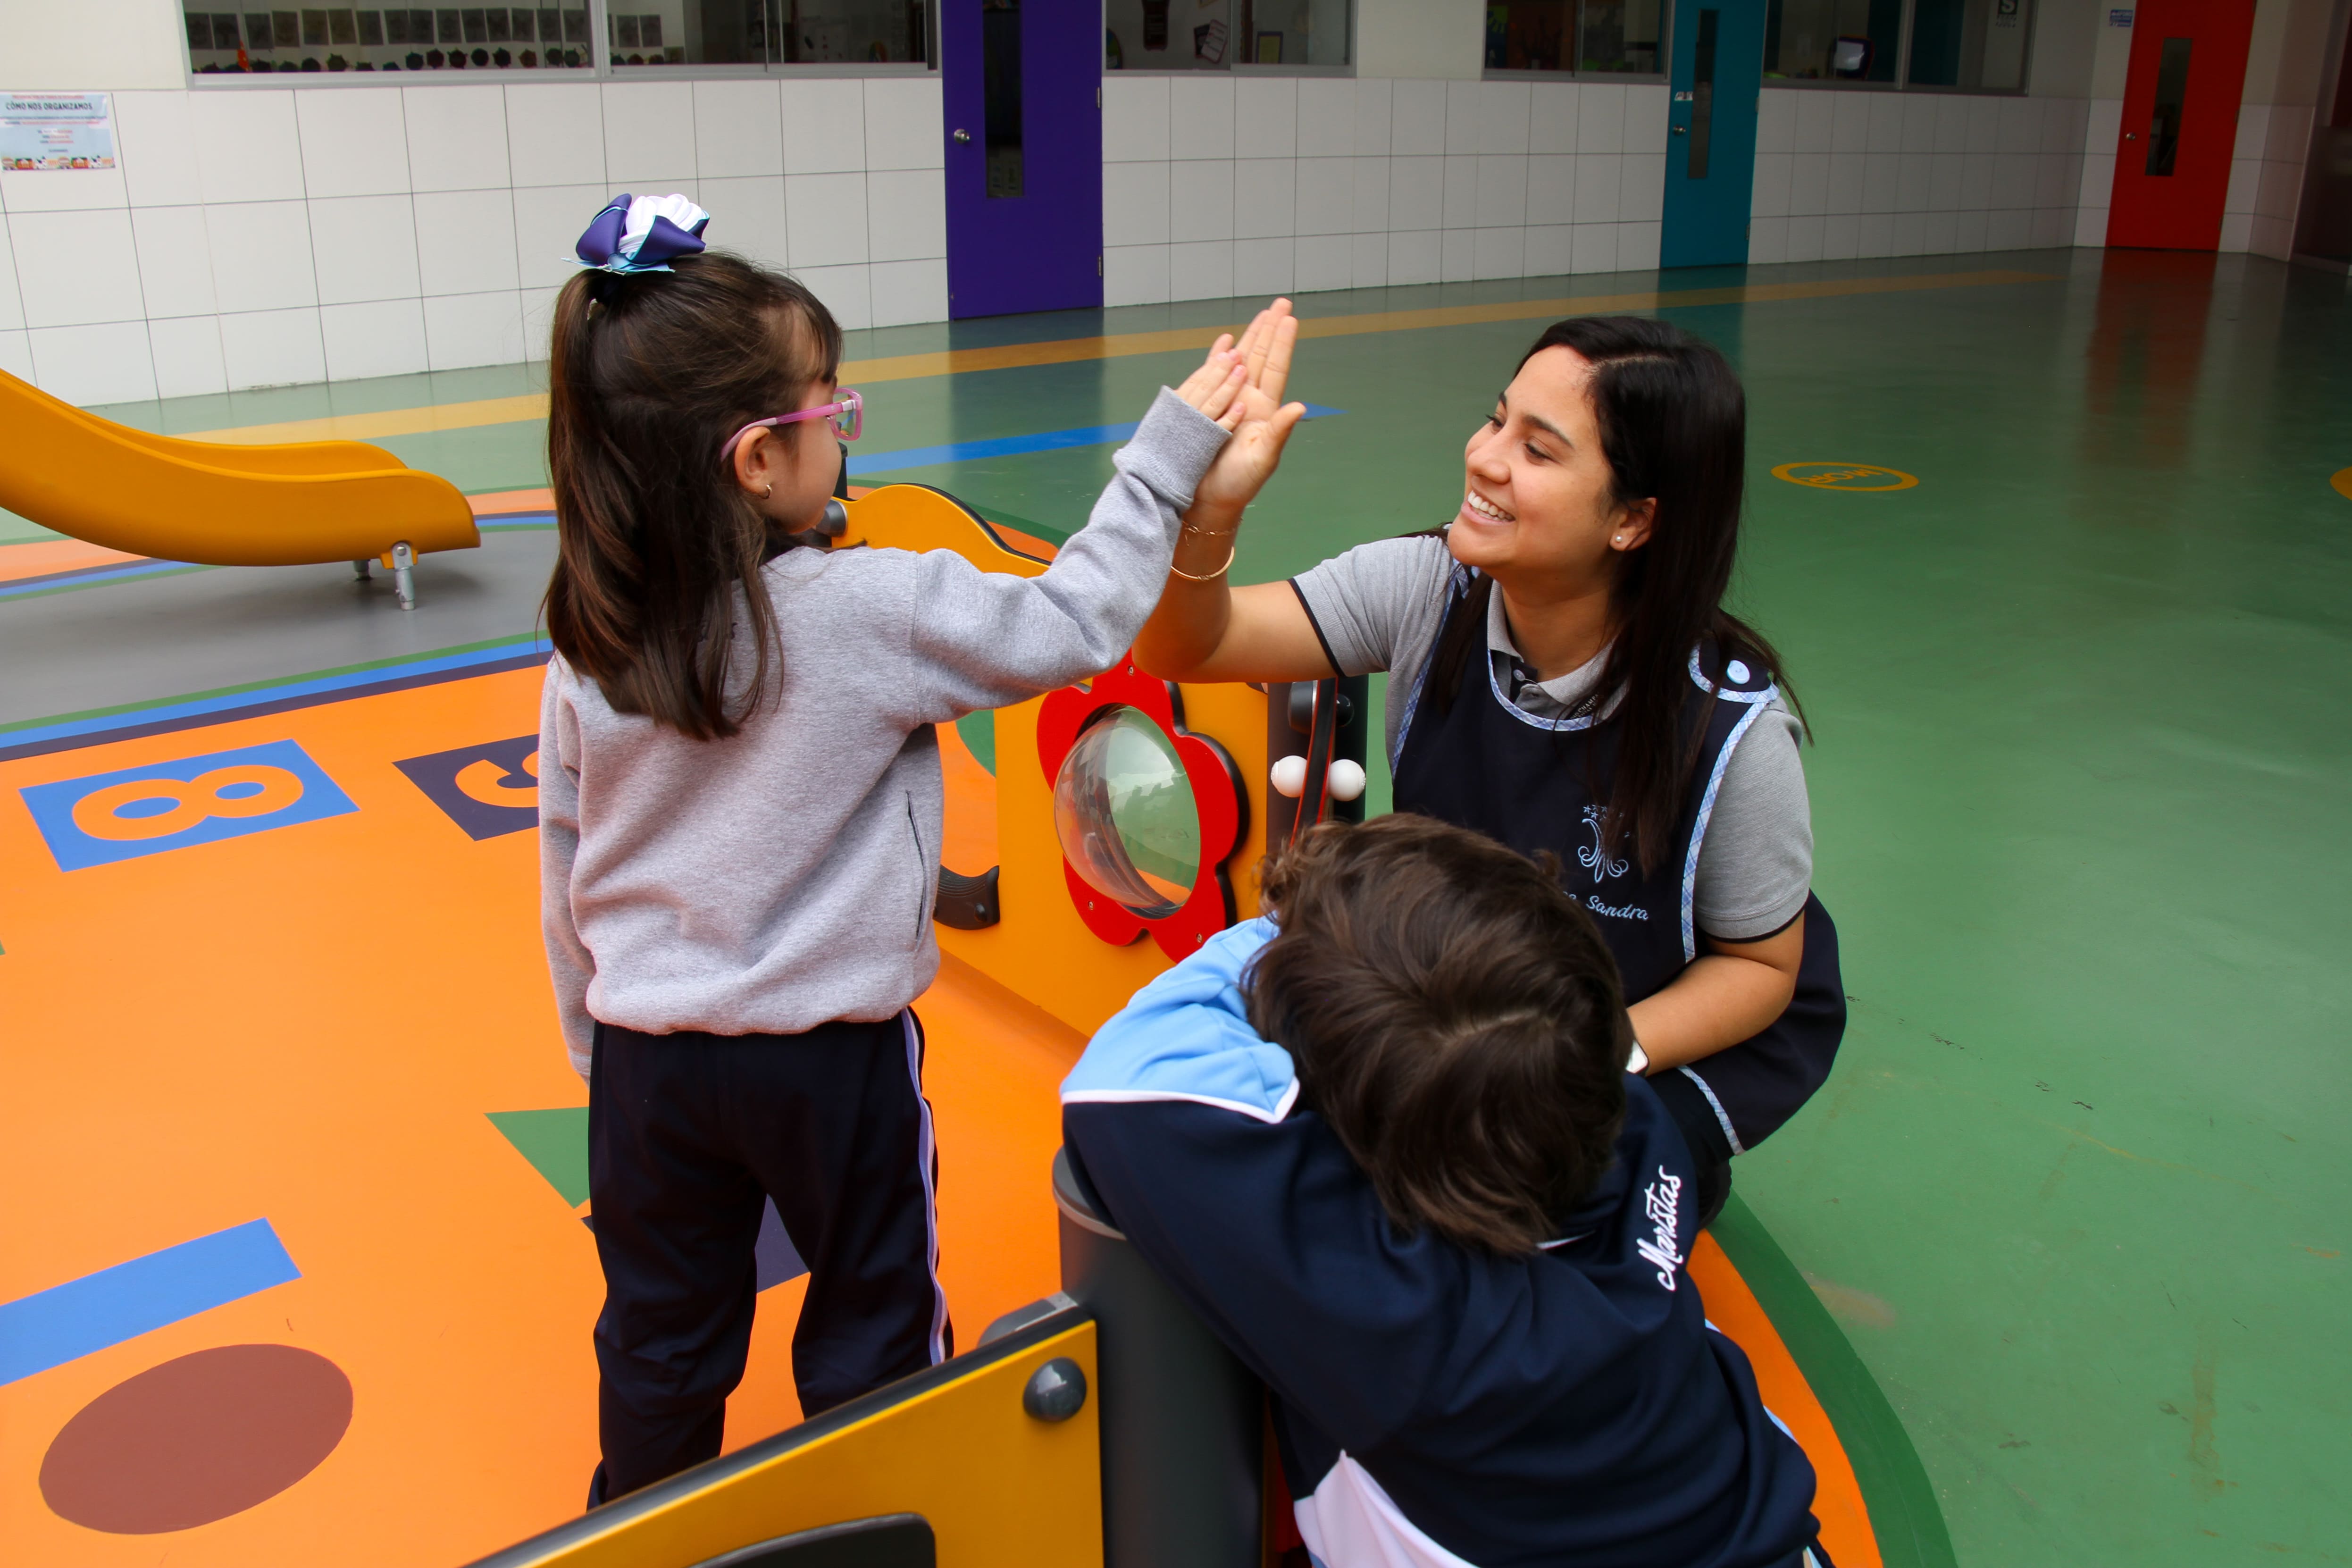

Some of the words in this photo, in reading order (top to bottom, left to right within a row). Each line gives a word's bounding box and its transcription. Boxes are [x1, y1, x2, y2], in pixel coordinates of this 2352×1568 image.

[72, 764, 304, 841] 8
[1585, 895, 1649, 922] Sandra
[1636, 1164, 1684, 1292] Maristas
